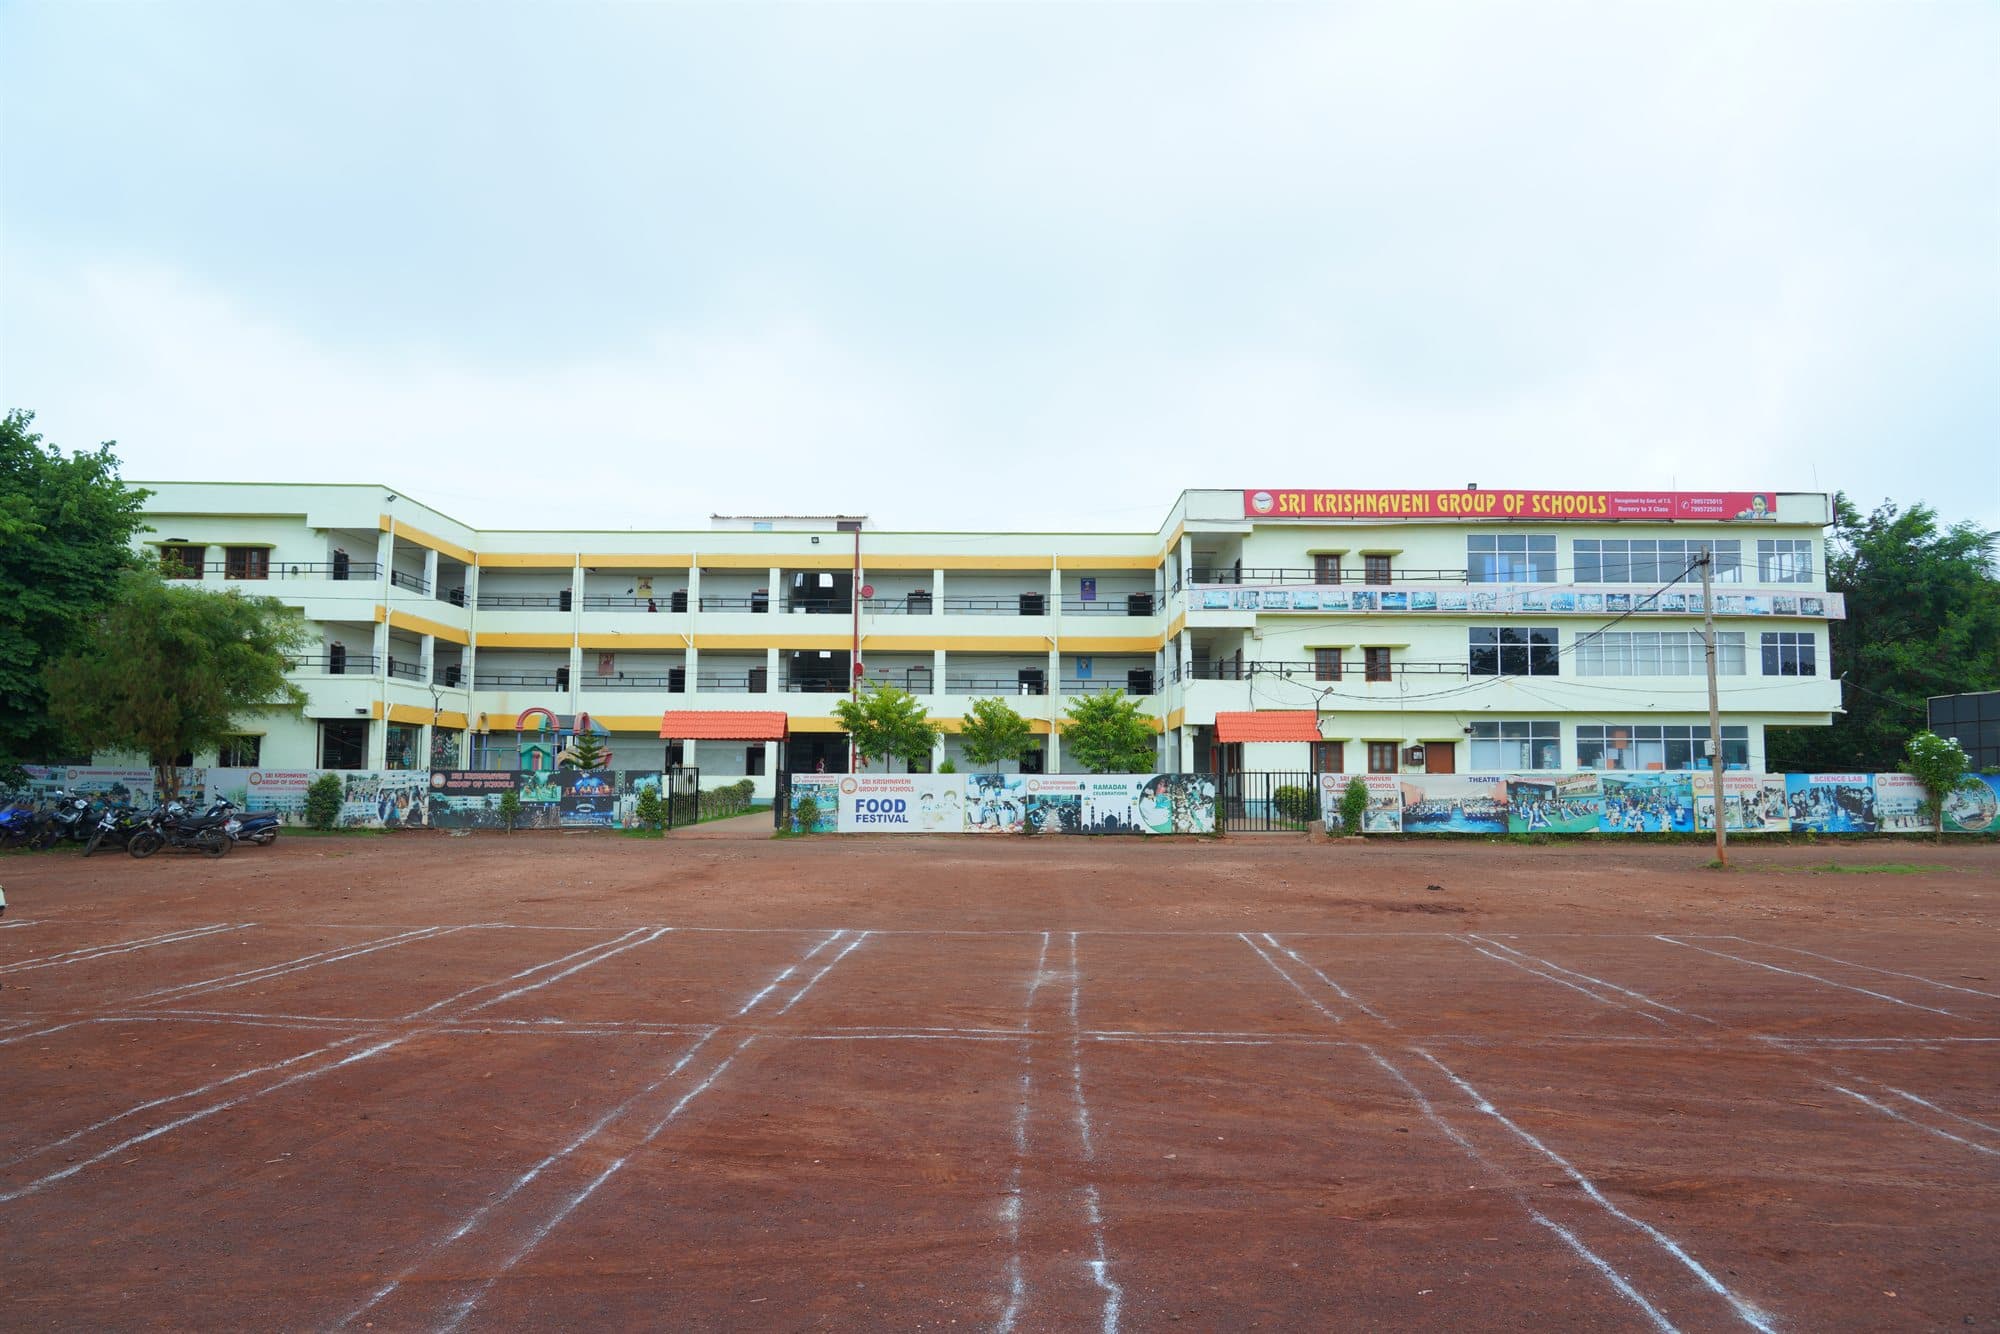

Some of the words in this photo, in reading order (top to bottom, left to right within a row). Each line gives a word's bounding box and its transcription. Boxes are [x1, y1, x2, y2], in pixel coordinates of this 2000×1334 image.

[1279, 494, 1305, 514] SRI
[1314, 494, 1430, 514] KRISHNAVENI
[1436, 494, 1496, 514] GROUP
[1503, 494, 1524, 514] OF
[1532, 494, 1606, 514] SCHOOLS
[856, 799, 906, 813] FOOD
[856, 814, 908, 823] FESTIVAL
